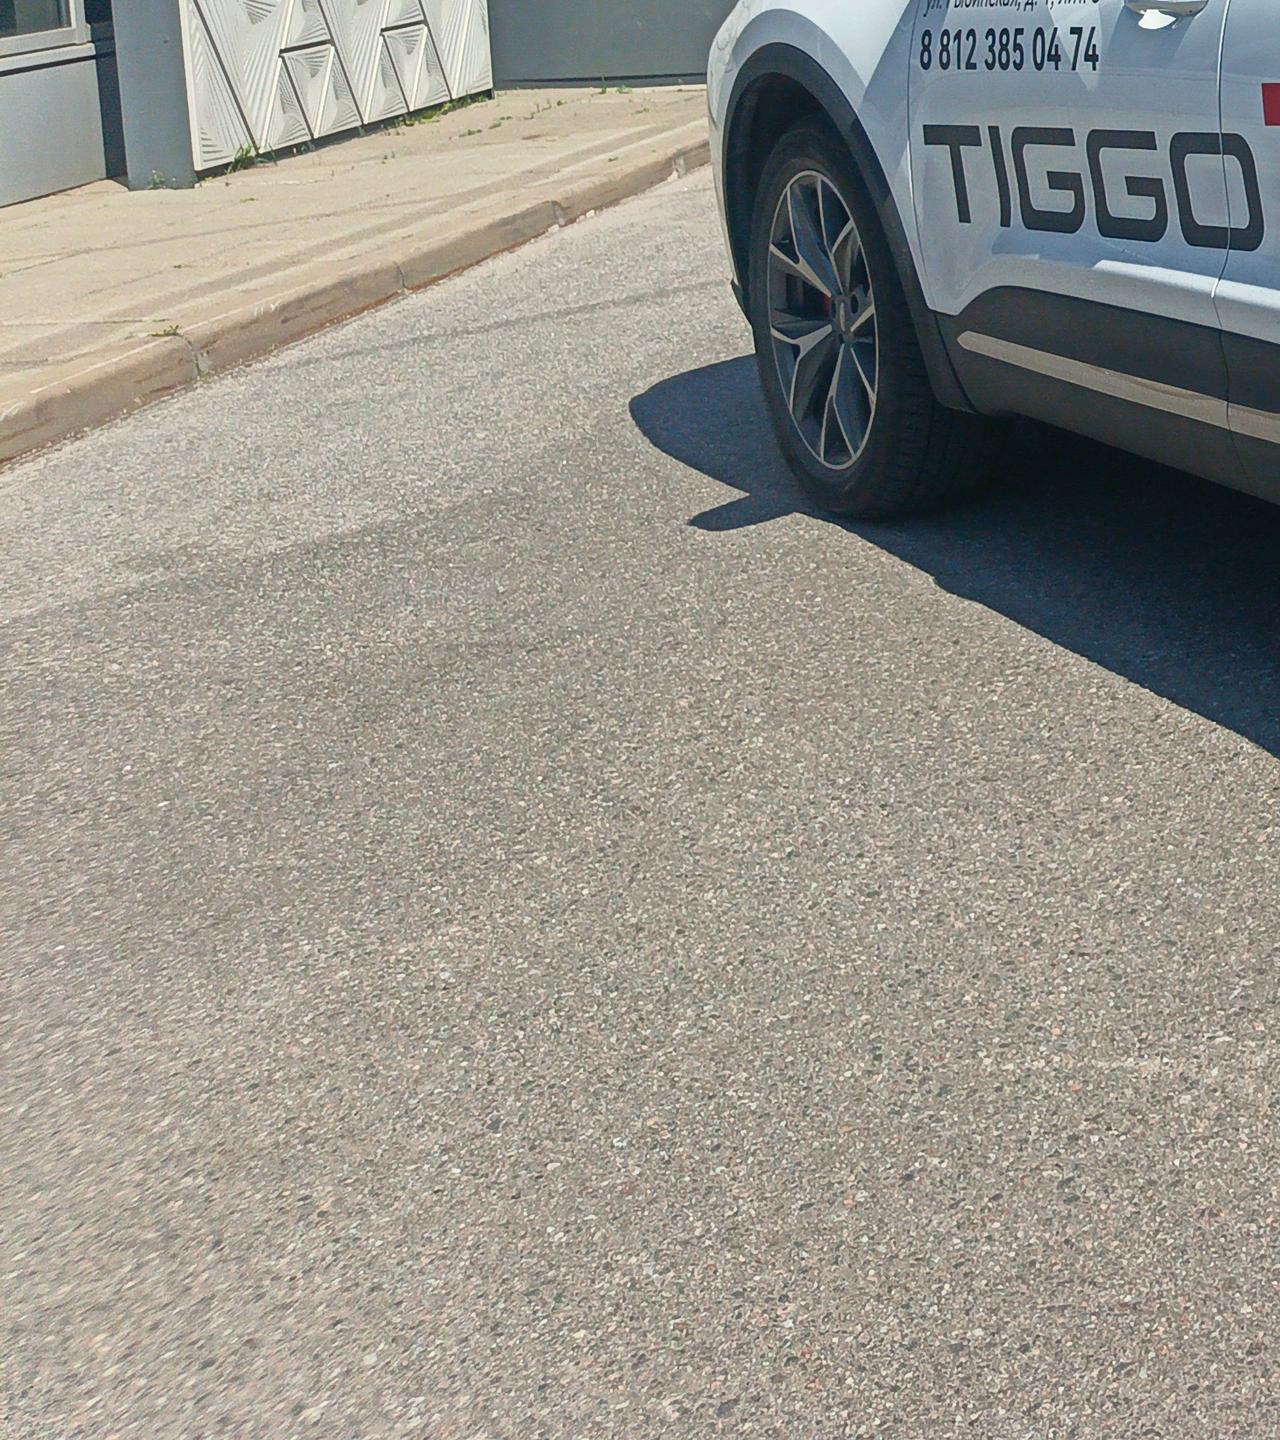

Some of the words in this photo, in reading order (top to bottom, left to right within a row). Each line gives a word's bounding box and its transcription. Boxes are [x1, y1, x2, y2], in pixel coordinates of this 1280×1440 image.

[919, 28, 932, 71] 8
[938, 27, 977, 71] 812
[984, 27, 1025, 71] 385
[1032, 26, 1062, 71] 04
[1069, 26, 1100, 71] 74
